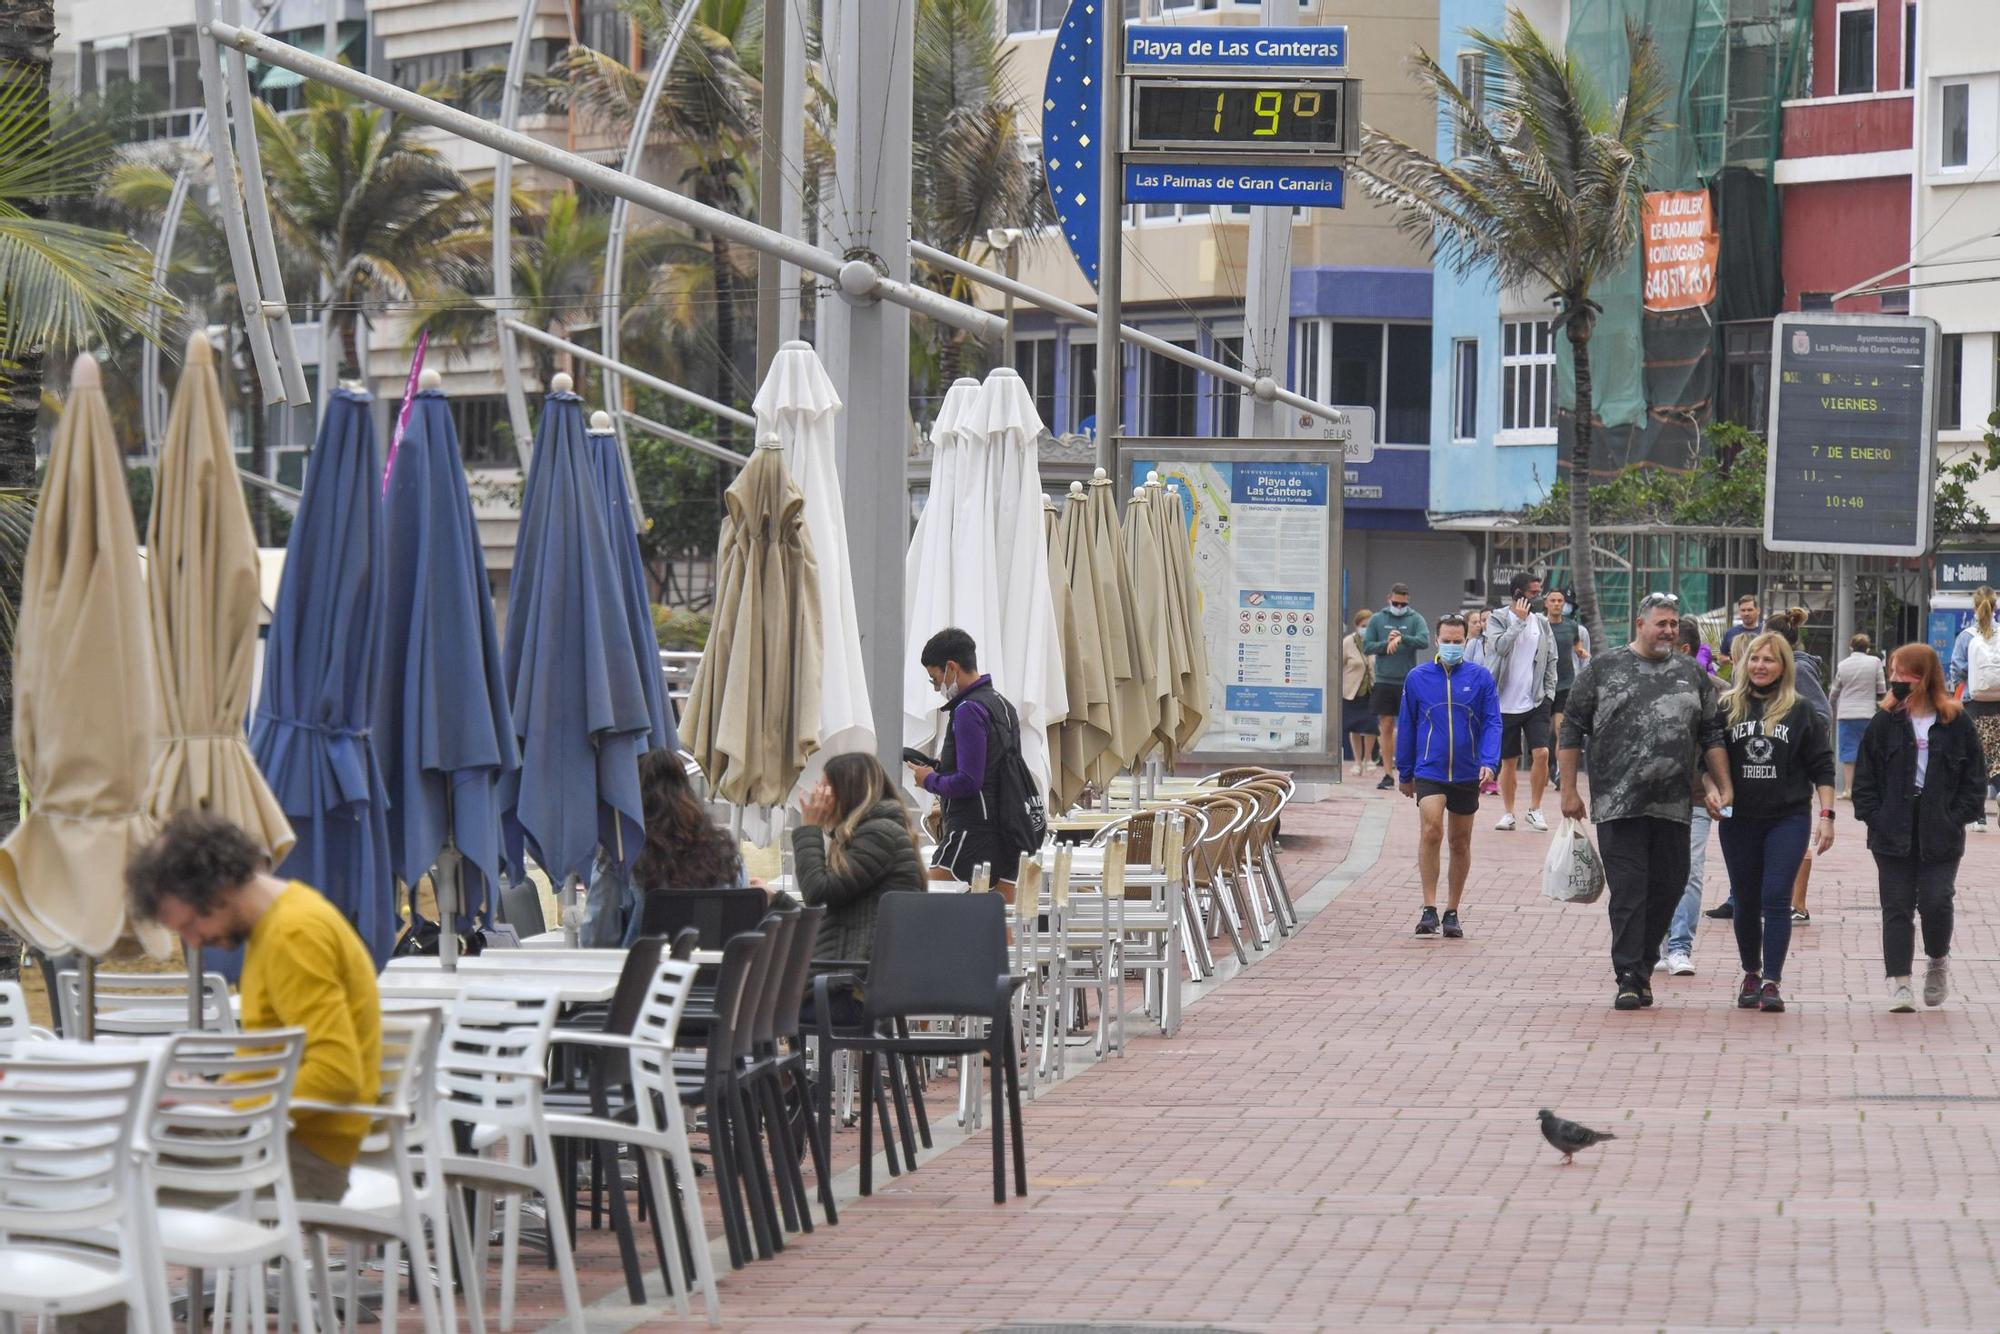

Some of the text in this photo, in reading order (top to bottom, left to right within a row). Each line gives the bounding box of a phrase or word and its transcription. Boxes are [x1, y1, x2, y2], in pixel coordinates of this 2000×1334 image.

[1132, 39, 1338, 60] Playa de Las Canteras
[1135, 173, 1333, 191] Las Palmas de Gran Canaria
[1856, 334, 1920, 345] Ayuntamiento de
[1815, 343, 1920, 355] Las Palmas de Gran Canaria
[1821, 397, 1878, 411] VIERNES
[1323, 428, 1335, 439] DE
[1811, 446, 1891, 460] 7 DE ENERO
[1258, 476, 1302, 488] Playa de
[1246, 485, 1313, 497] Las Canteras
[1732, 720, 1790, 744] NEW YRK
[1742, 765, 1777, 779] TRIBECA
